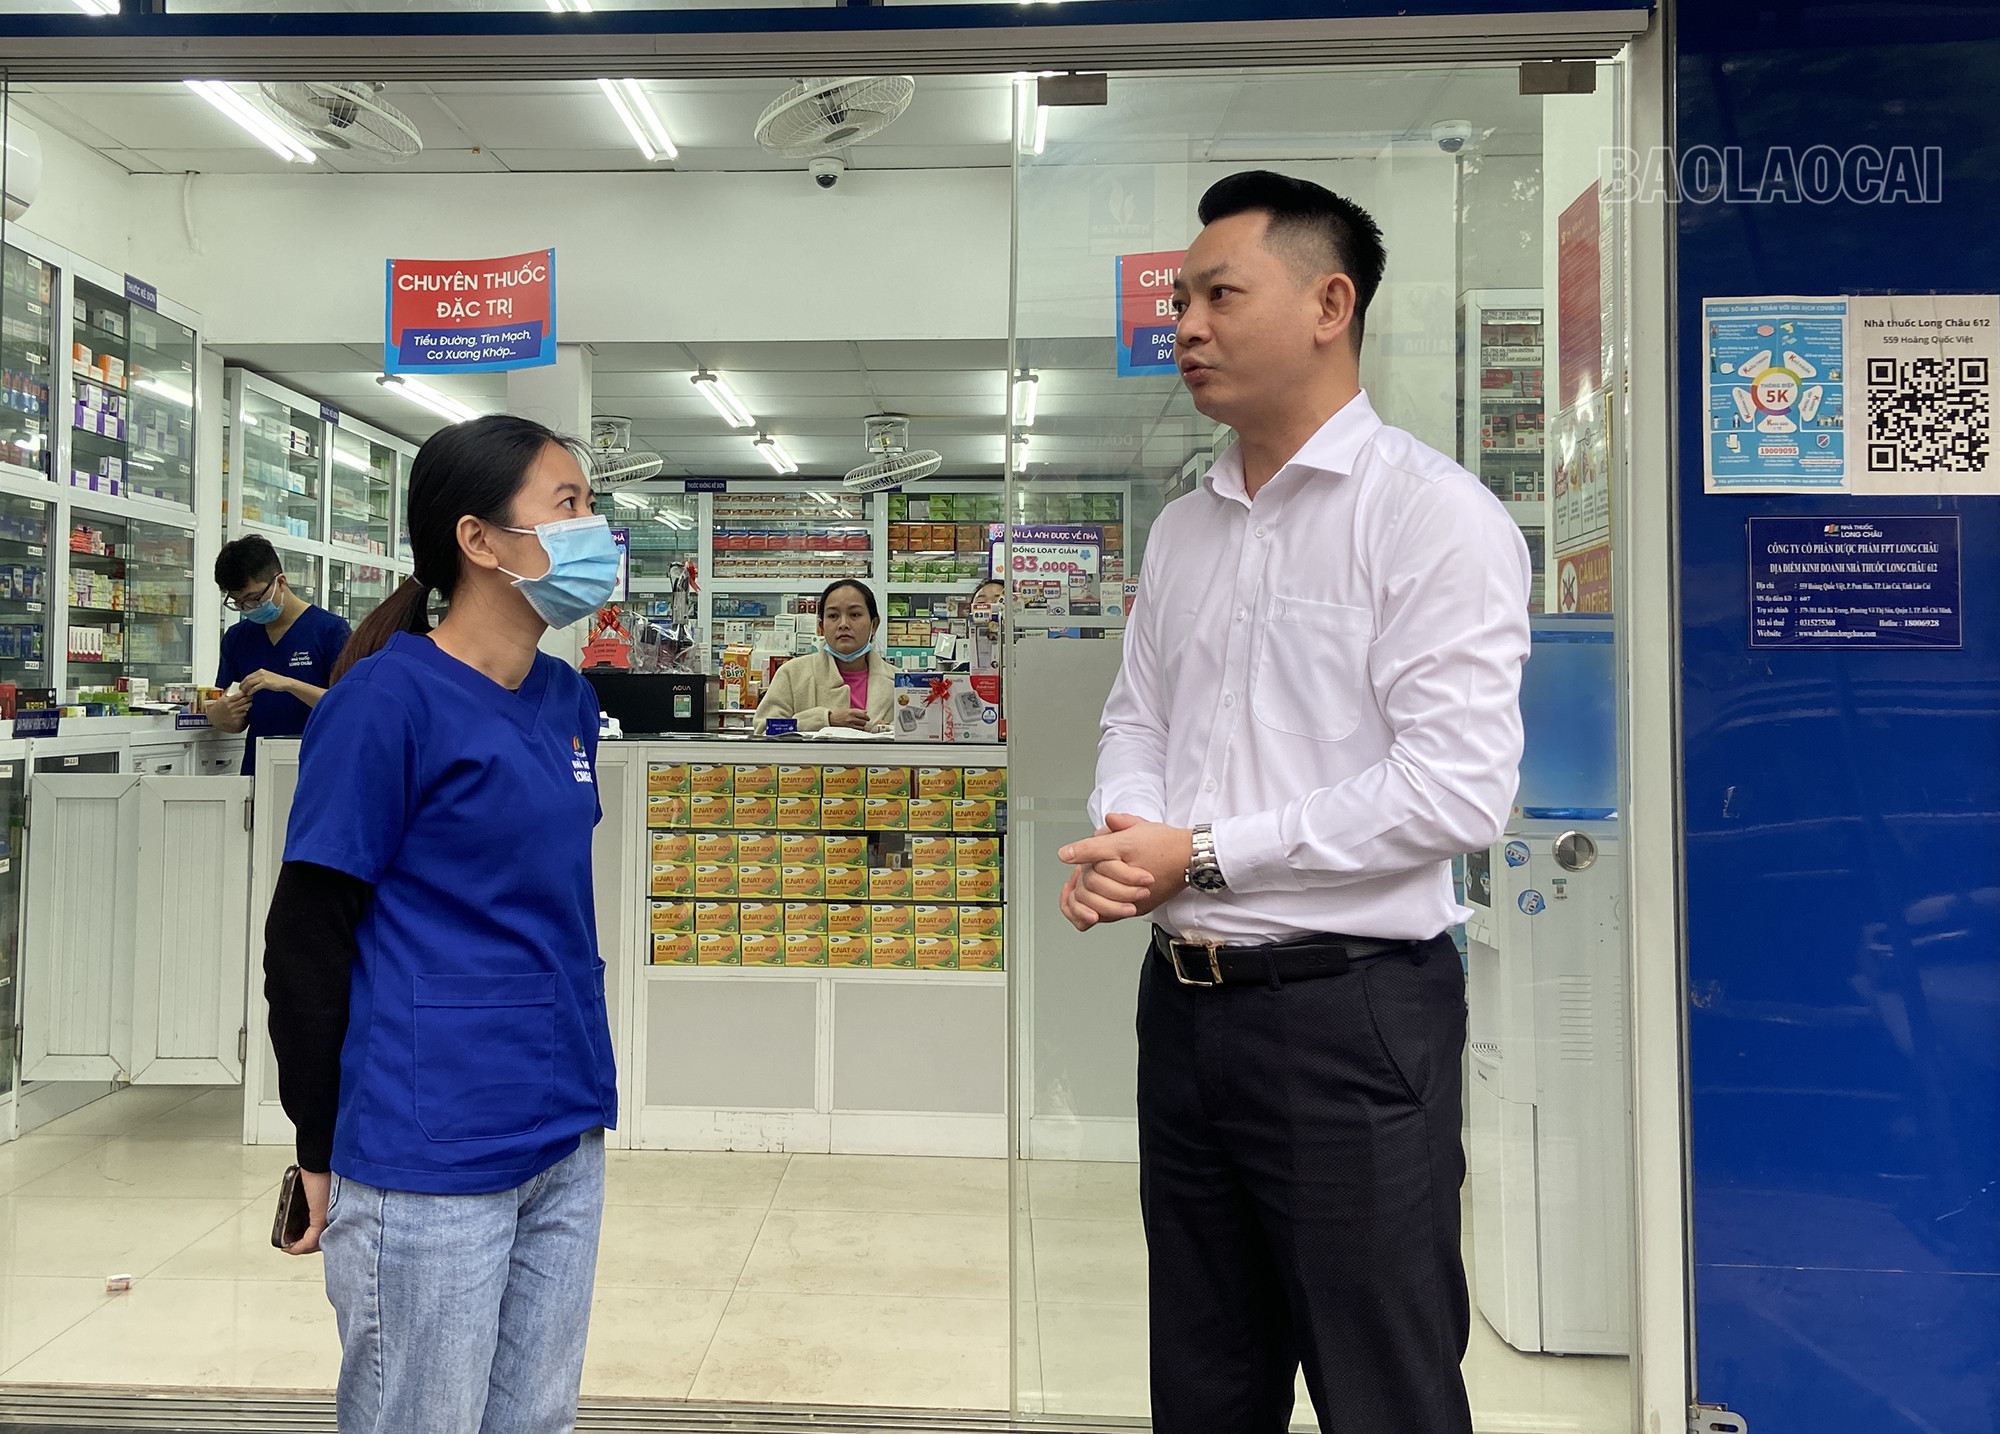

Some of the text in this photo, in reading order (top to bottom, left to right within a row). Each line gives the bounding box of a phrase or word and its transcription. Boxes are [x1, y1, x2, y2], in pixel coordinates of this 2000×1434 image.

[398, 261, 546, 291] CHUYÊN THUỐC
[436, 297, 513, 322] ĐẶC TRỊ
[1887, 319, 1915, 327] thuốc
[1919, 320, 1942, 329] Long
[1945, 319, 1970, 327] Châu
[1973, 319, 1990, 327] 612
[414, 330, 532, 348] Tiểu Đường, Tim Mạch,
[1901, 336, 1929, 345] Hoàng
[1931, 335, 1954, 344] Quốc
[1956, 336, 1973, 344] Việt
[427, 350, 444, 360] Cơ
[445, 349, 480, 361] Xương
[1158, 350, 1173, 359] BV
[1766, 390, 1788, 403] 5K
[1862, 530, 1882, 538] CHÂU
[1767, 542, 1788, 553] CÔNG
[1790, 544, 1800, 553] TY
[1835, 544, 1856, 556] DƯỢC
[1881, 544, 1894, 553] FPT
[1895, 544, 1917, 553] LONG
[1918, 541, 1939, 553] CHÂU
[1802, 563, 1819, 572] KINH
[1820, 563, 1845, 572] DOANH
[1846, 561, 1860, 572] NHÀ
[1861, 561, 1885, 572] THUỐC
[1886, 563, 1906, 572] LONG
[1907, 560, 1926, 572] CHÂU
[1927, 563, 1938, 572] 612
